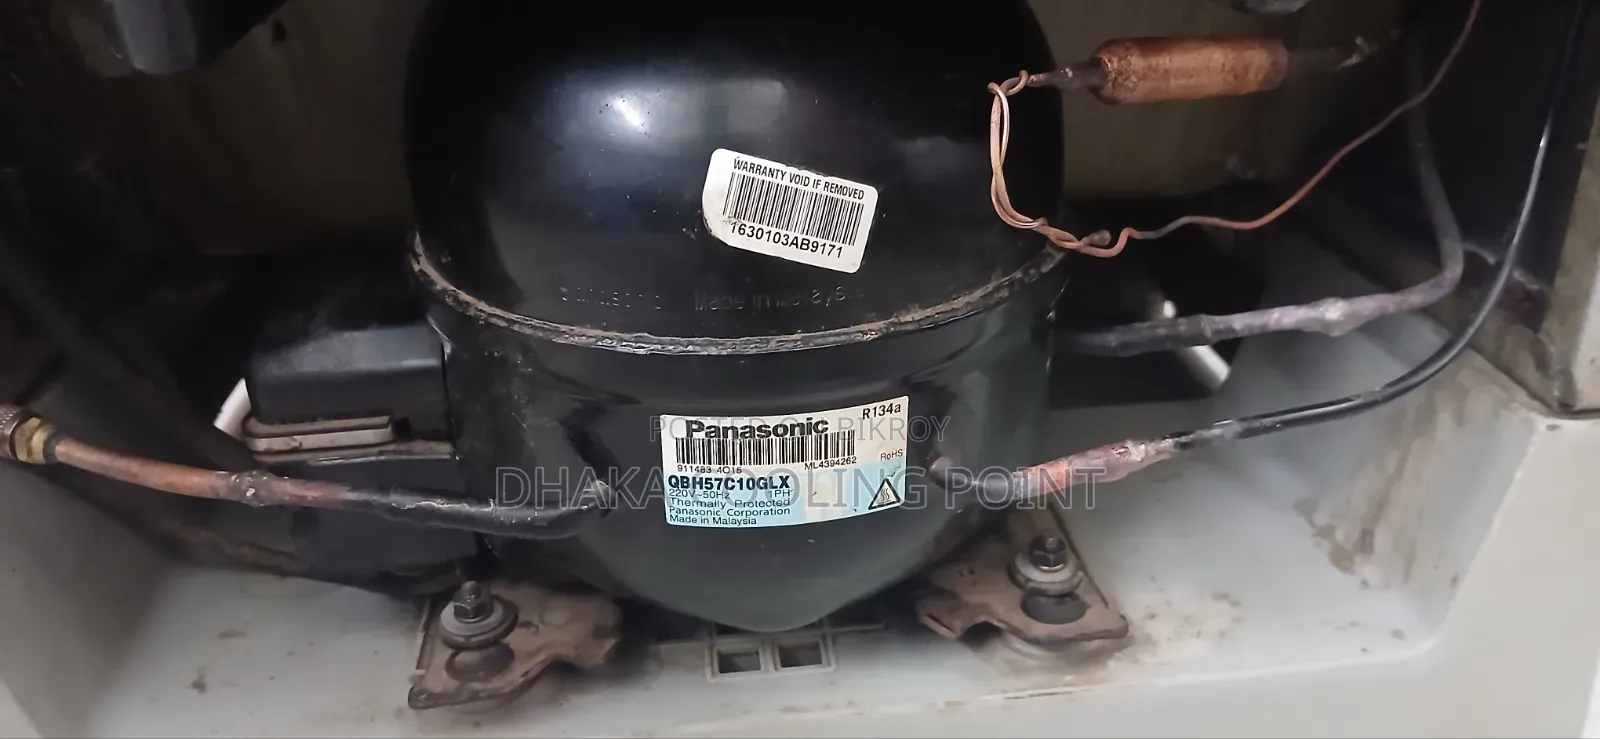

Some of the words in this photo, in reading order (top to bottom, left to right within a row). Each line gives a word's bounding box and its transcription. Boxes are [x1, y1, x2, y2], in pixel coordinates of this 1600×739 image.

[733, 157, 787, 181] WARRANTY
[789, 171, 811, 188] VOID
[812, 178, 822, 190] IF
[824, 181, 865, 201] REMOVED
[730, 220, 843, 259] 1630103AB9171
[862, 403, 902, 420] R134a
[685, 416, 830, 440] Panasonic
[880, 448, 904, 461] RoHS
[804, 456, 858, 471] ML4394262
[667, 474, 791, 491] QBH57C10GLX
[670, 497, 727, 510] Thermally
[734, 498, 791, 508] Protected
[669, 506, 721, 517] Panasonic
[726, 507, 791, 518] Corporation
[669, 514, 698, 524] Made
[700, 514, 710, 524] in
[712, 516, 757, 526] Malaysia
